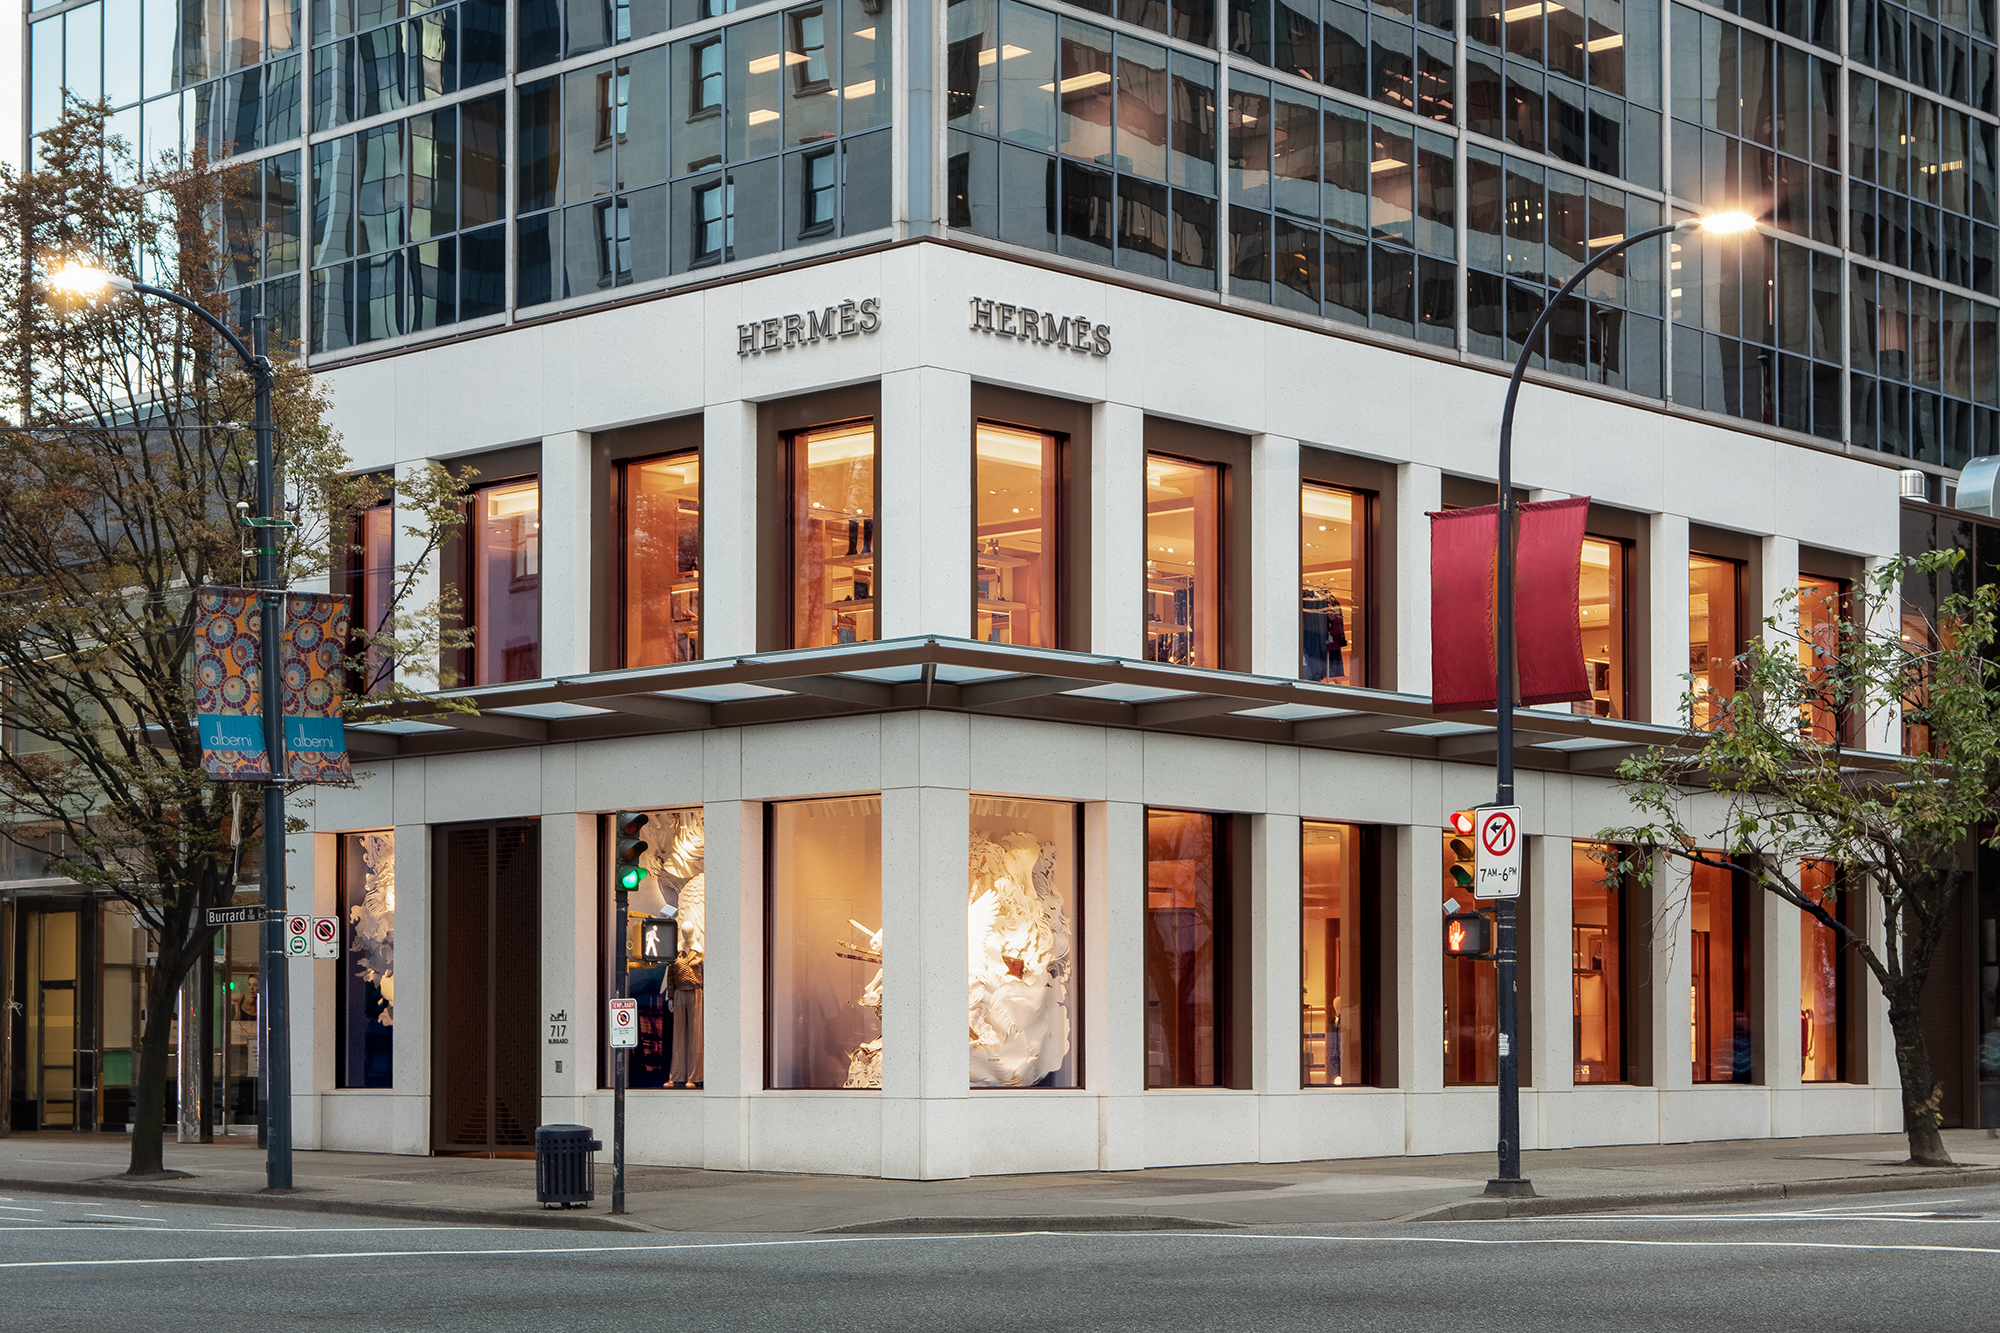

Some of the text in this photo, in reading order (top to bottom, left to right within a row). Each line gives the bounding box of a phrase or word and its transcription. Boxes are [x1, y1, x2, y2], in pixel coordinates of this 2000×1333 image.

[737, 297, 881, 356] HERMÈS
[969, 296, 1111, 356] HERMÈS
[210, 721, 252, 746] alberni
[293, 723, 334, 748] alberni
[209, 909, 245, 922] Burrard
[550, 1025, 567, 1037] 717
